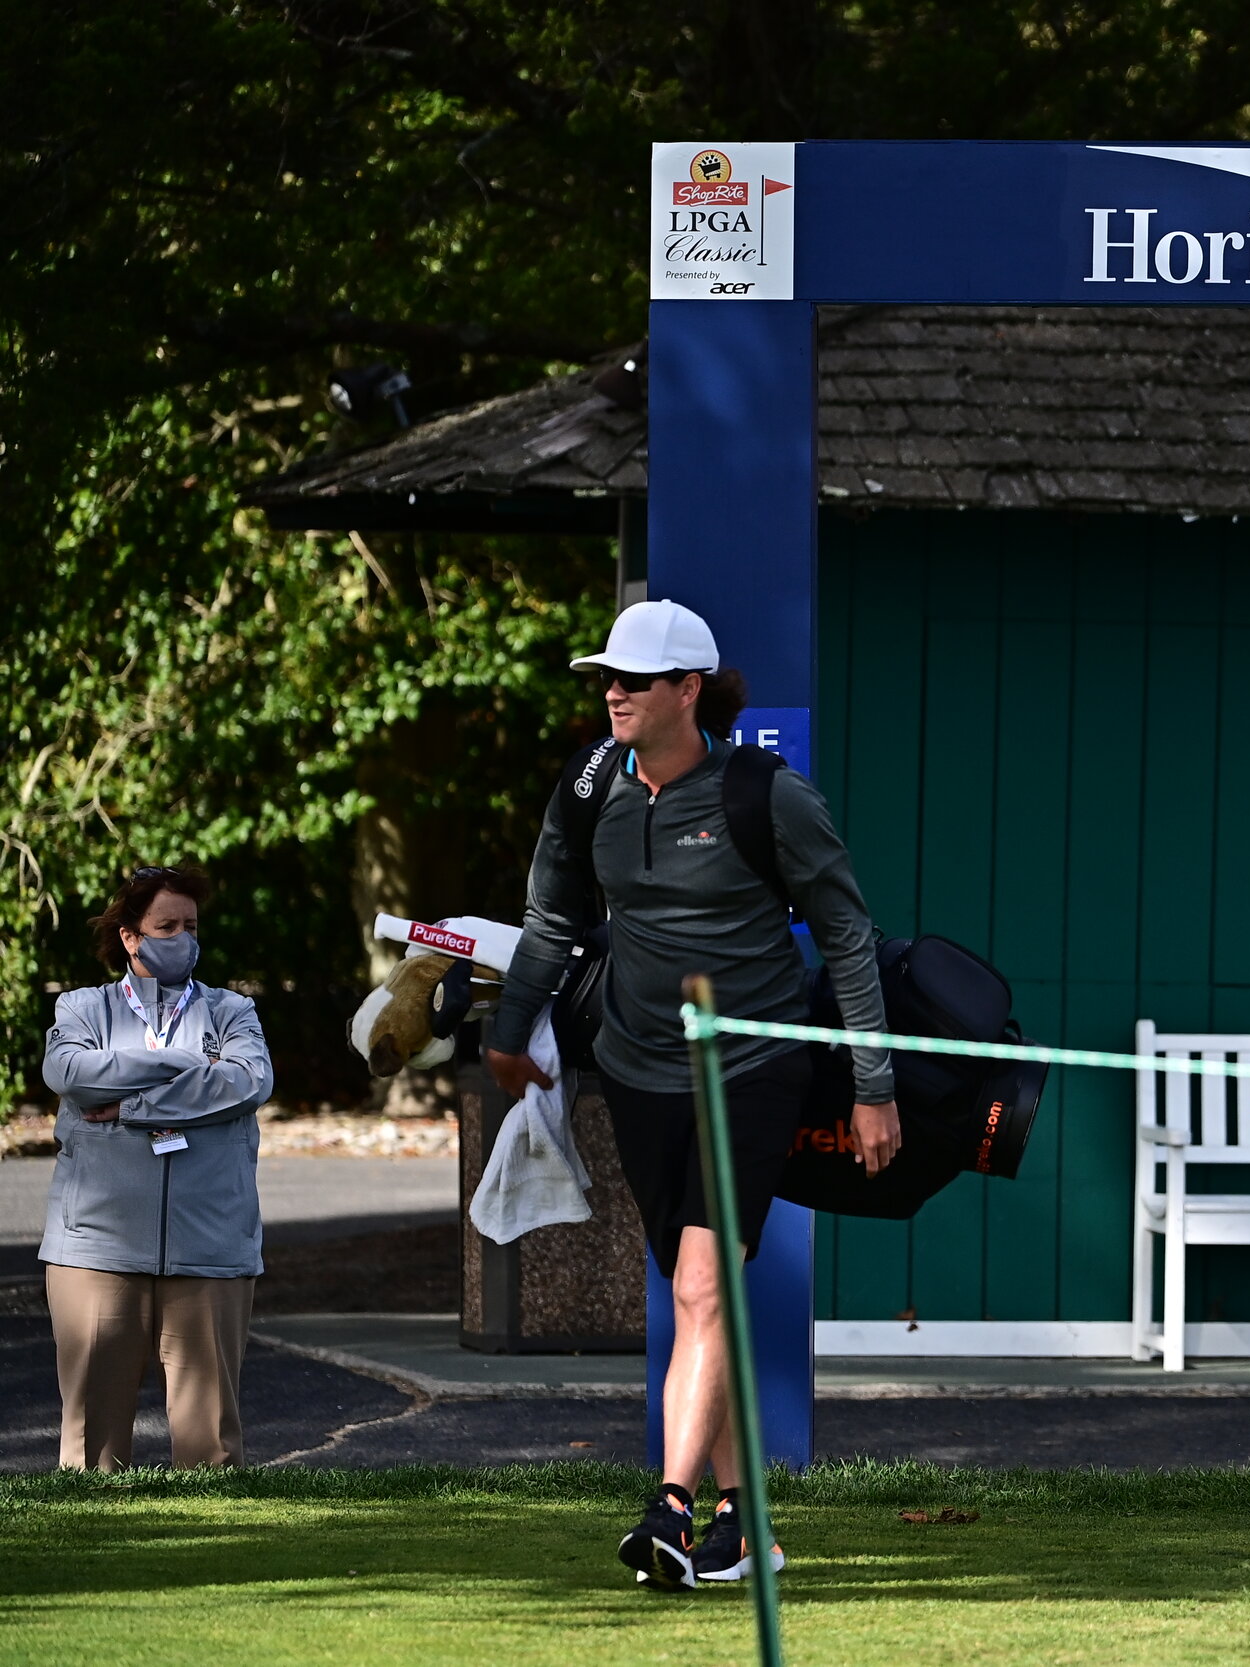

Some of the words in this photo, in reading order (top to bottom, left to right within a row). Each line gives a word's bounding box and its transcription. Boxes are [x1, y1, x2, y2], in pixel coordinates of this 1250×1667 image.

[676, 185, 744, 207] ShopRite
[669, 211, 753, 233] LPGA
[664, 234, 757, 262] Classic
[665, 271, 707, 279] Presented
[709, 271, 721, 281] by
[710, 283, 756, 295] acer
[676, 835, 717, 847] ellesse
[413, 926, 471, 952] Purefect
